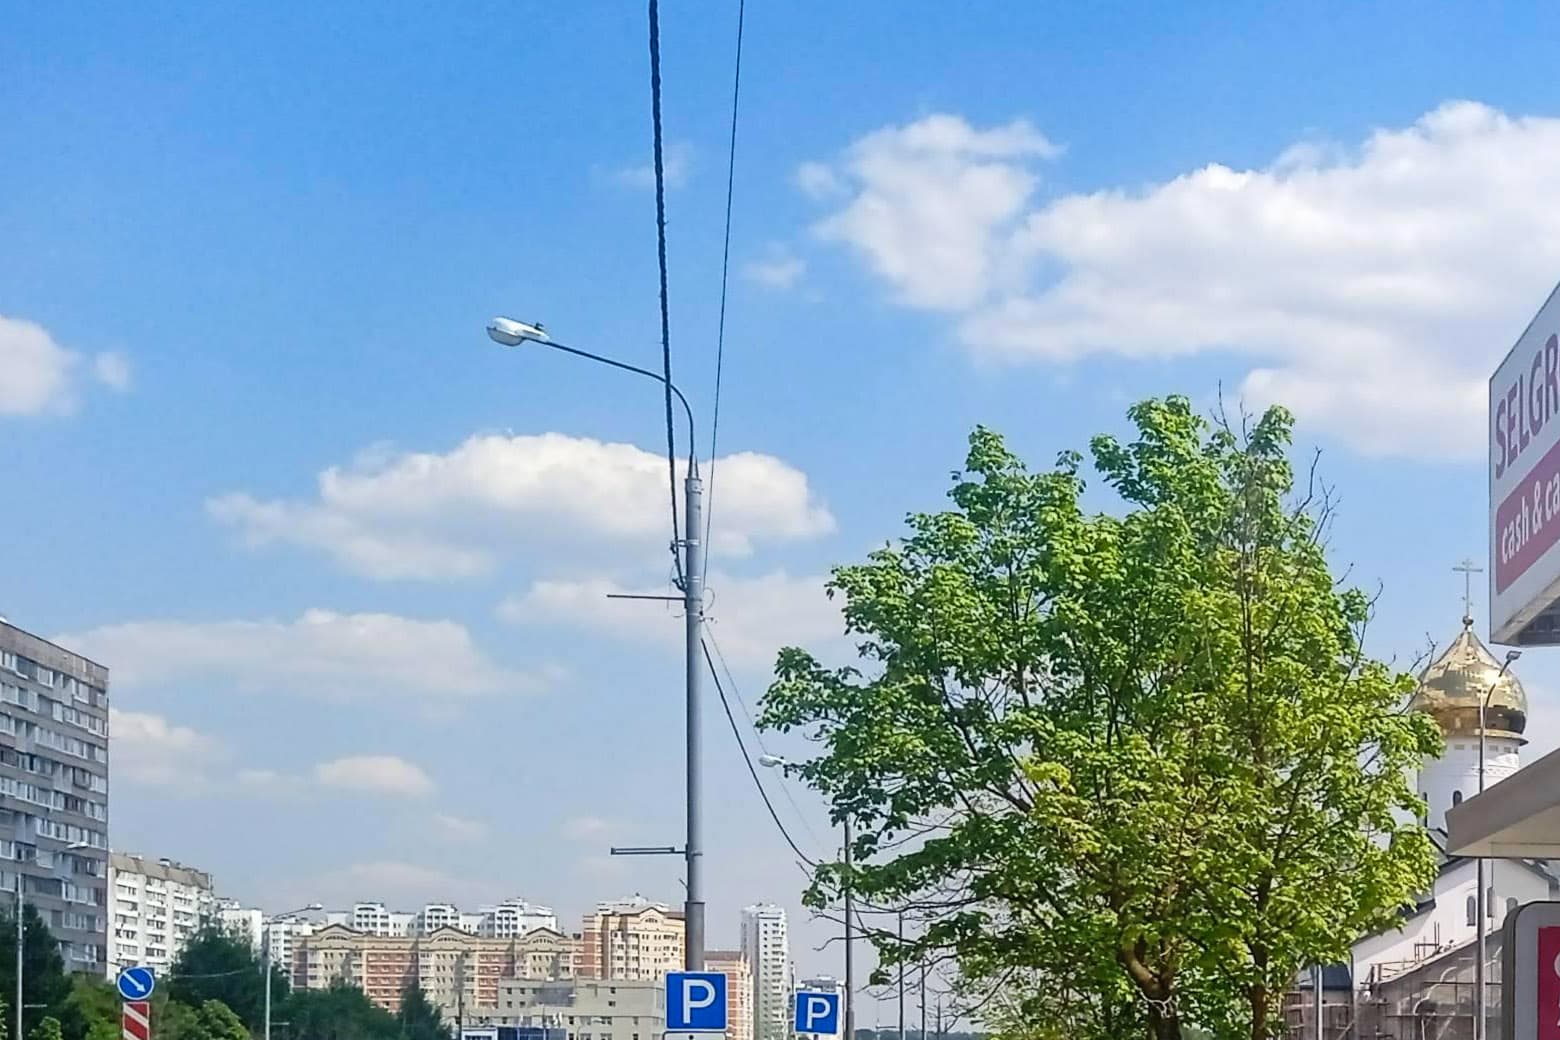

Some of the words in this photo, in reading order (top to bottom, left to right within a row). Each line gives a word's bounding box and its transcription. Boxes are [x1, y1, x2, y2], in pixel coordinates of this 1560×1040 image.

[1501, 495, 1530, 566] cash
[1532, 479, 1543, 534] &
[682, 978, 716, 1025] P
[806, 997, 831, 1030] P
